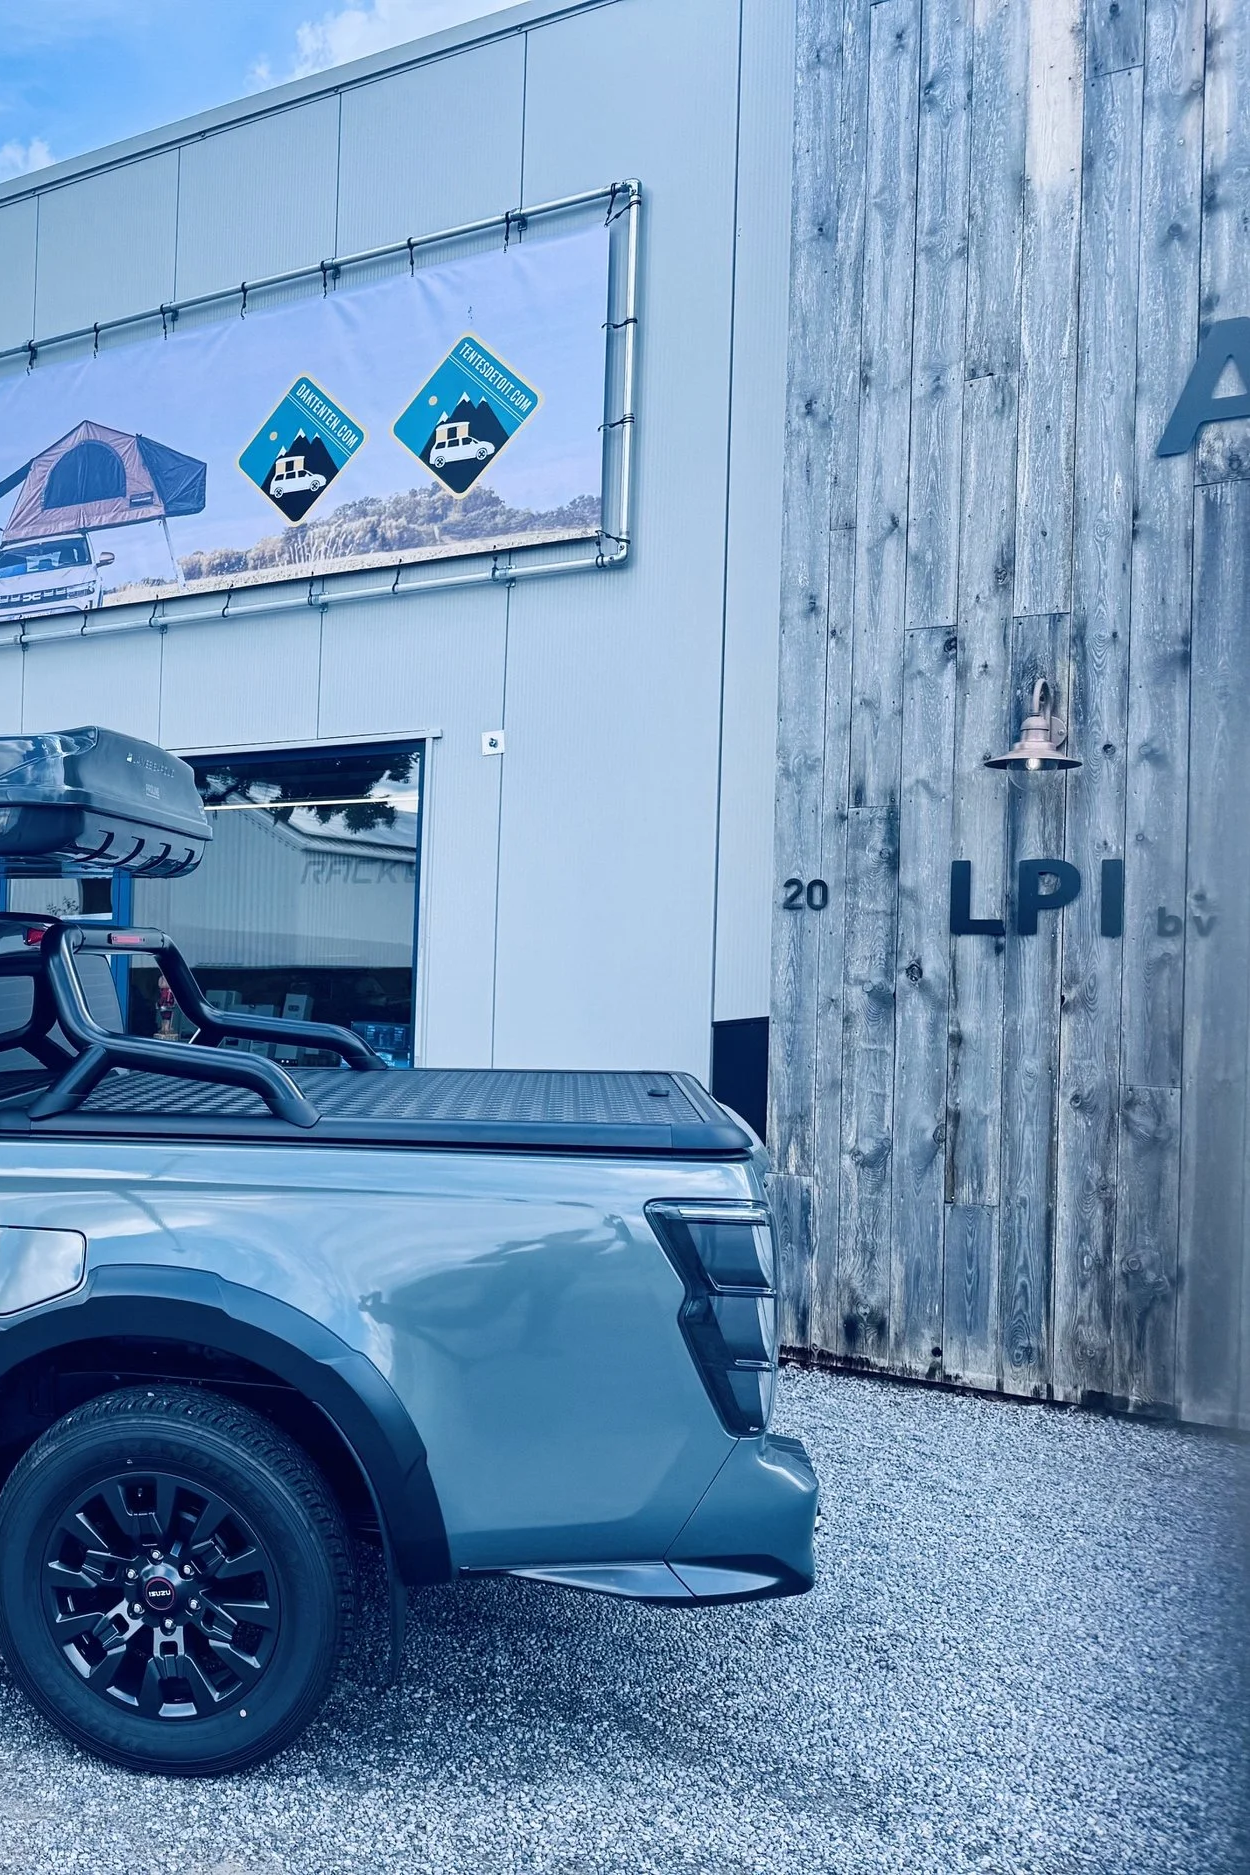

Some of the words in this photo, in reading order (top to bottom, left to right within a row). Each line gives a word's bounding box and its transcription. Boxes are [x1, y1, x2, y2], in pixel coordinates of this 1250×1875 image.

[459, 342, 532, 413] TENTESDETOIT.COM
[295, 383, 359, 450] DAKTENTEN.COM
[782, 878, 829, 911] 20
[949, 858, 1125, 938] LPI
[148, 1589, 171, 1597] ISUZU
